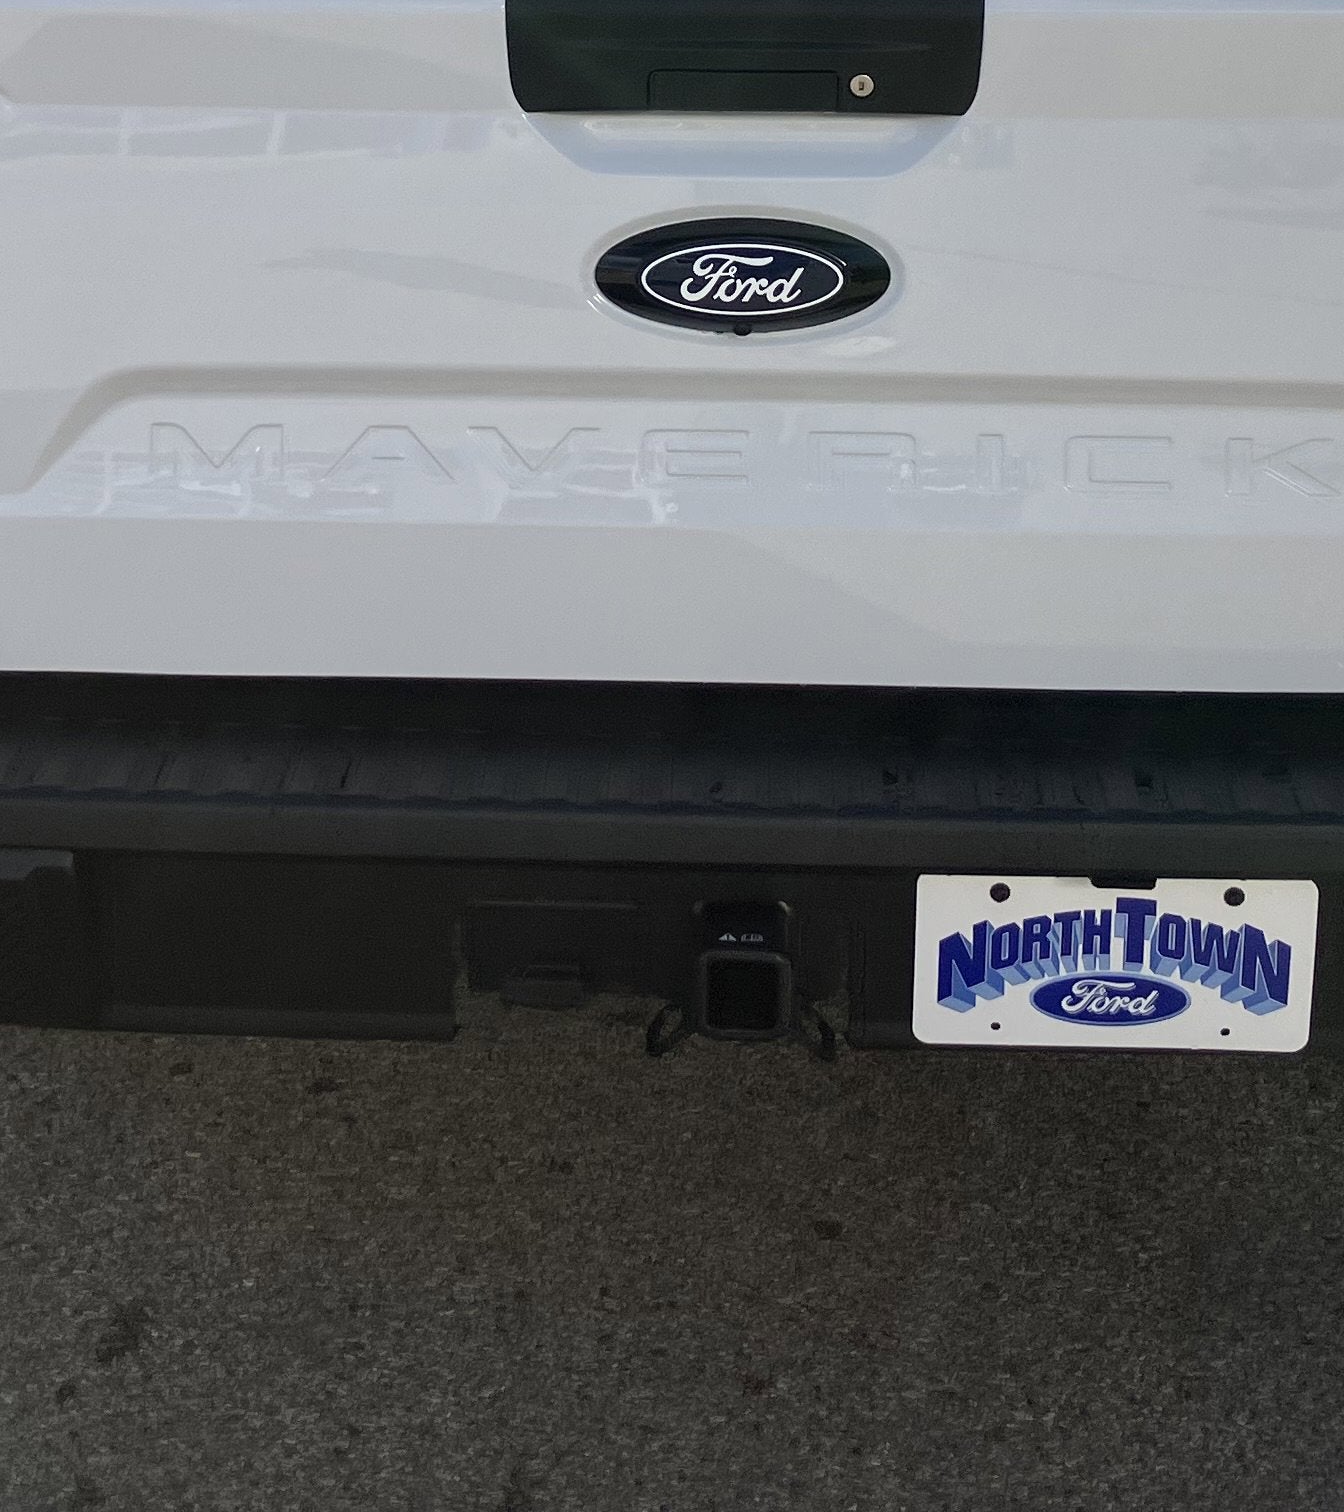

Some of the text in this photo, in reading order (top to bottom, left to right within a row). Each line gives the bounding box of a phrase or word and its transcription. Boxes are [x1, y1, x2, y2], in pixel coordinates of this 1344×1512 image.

[680, 253, 805, 303] Ford
[148, 421, 1343, 497] MAVERICK
[1061, 978, 1159, 1016] Ford
